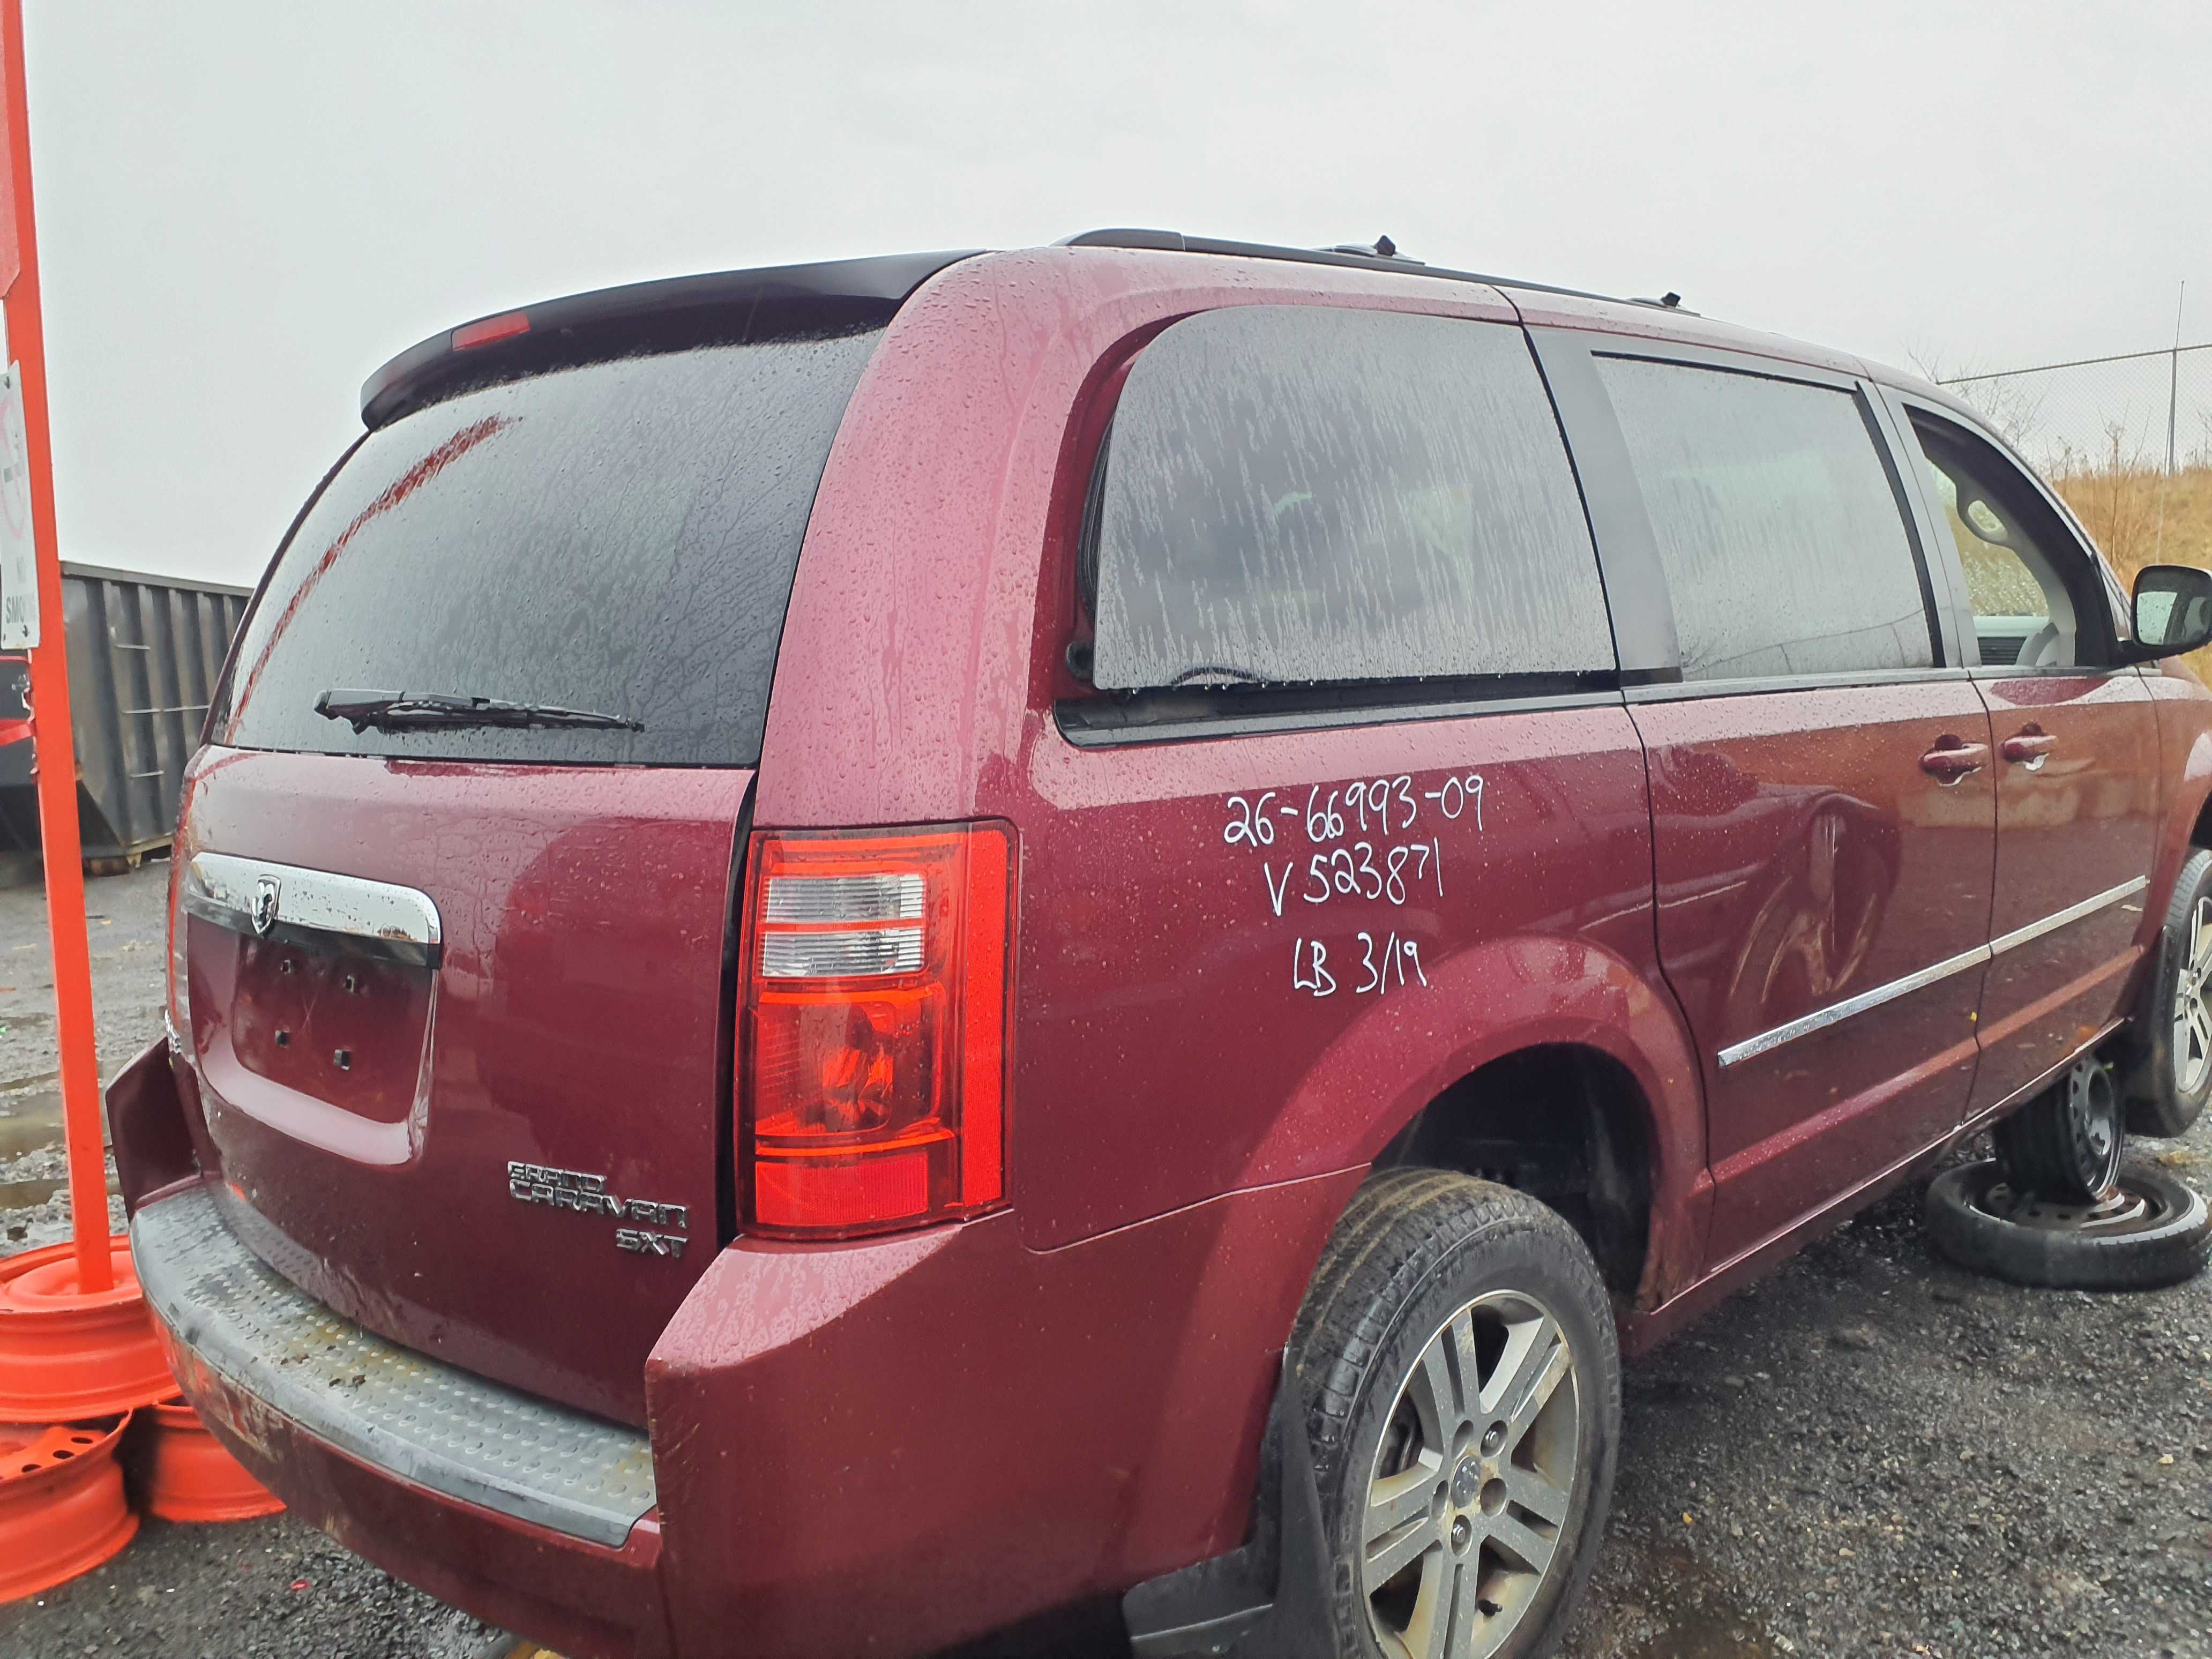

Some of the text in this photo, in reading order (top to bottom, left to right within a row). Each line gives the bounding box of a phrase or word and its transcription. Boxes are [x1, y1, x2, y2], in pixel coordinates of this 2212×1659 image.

[1223, 775, 1484, 847] 26-66993-09
[1303, 836, 1444, 906] 523871
[1293, 931, 1428, 997] LB 3/19
[509, 1178, 688, 1229] CARAVAN
[616, 1228, 688, 1259] SXT
